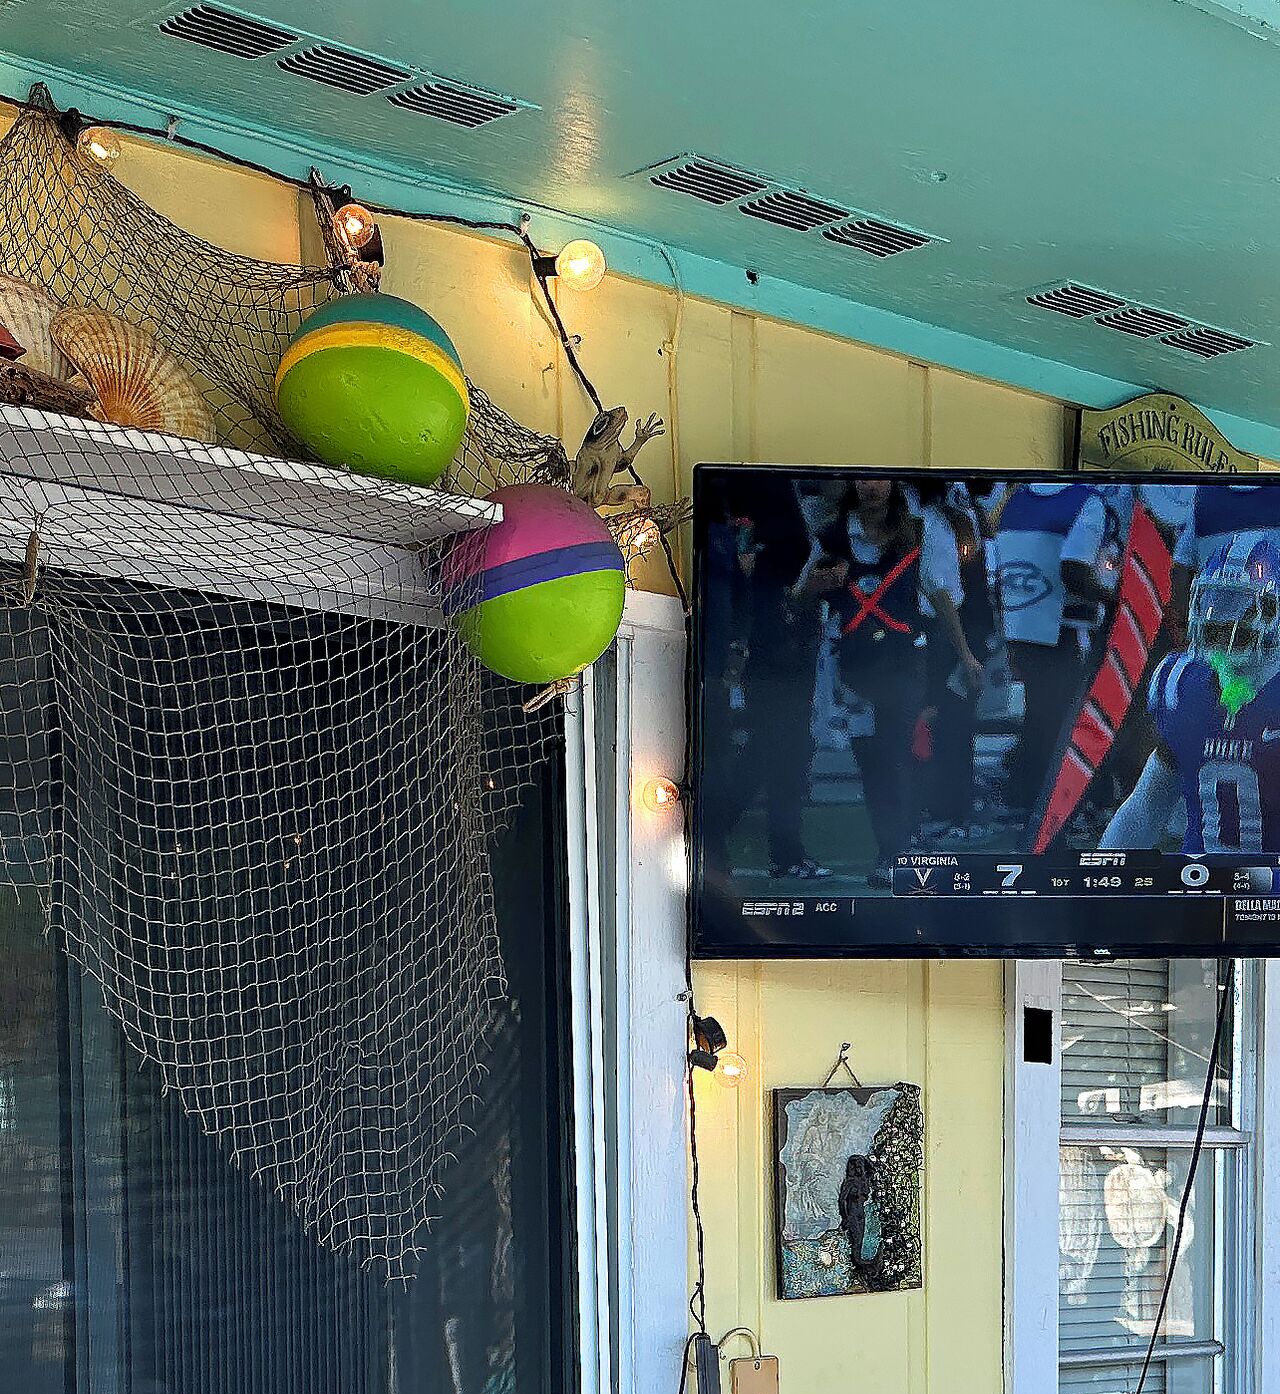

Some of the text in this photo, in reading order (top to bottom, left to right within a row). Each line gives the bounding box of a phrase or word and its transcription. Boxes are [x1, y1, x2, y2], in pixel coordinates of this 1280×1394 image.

[1097, 410, 1181, 460] FISHING
[910, 856, 958, 866] VIRGINIA
[1080, 853, 1126, 867] ESPN
[996, 864, 1023, 887] 7
[1083, 876, 1122, 888] 1:49
[1180, 863, 1210, 887] 0
[742, 902, 838, 916] ESPN2 ACC
